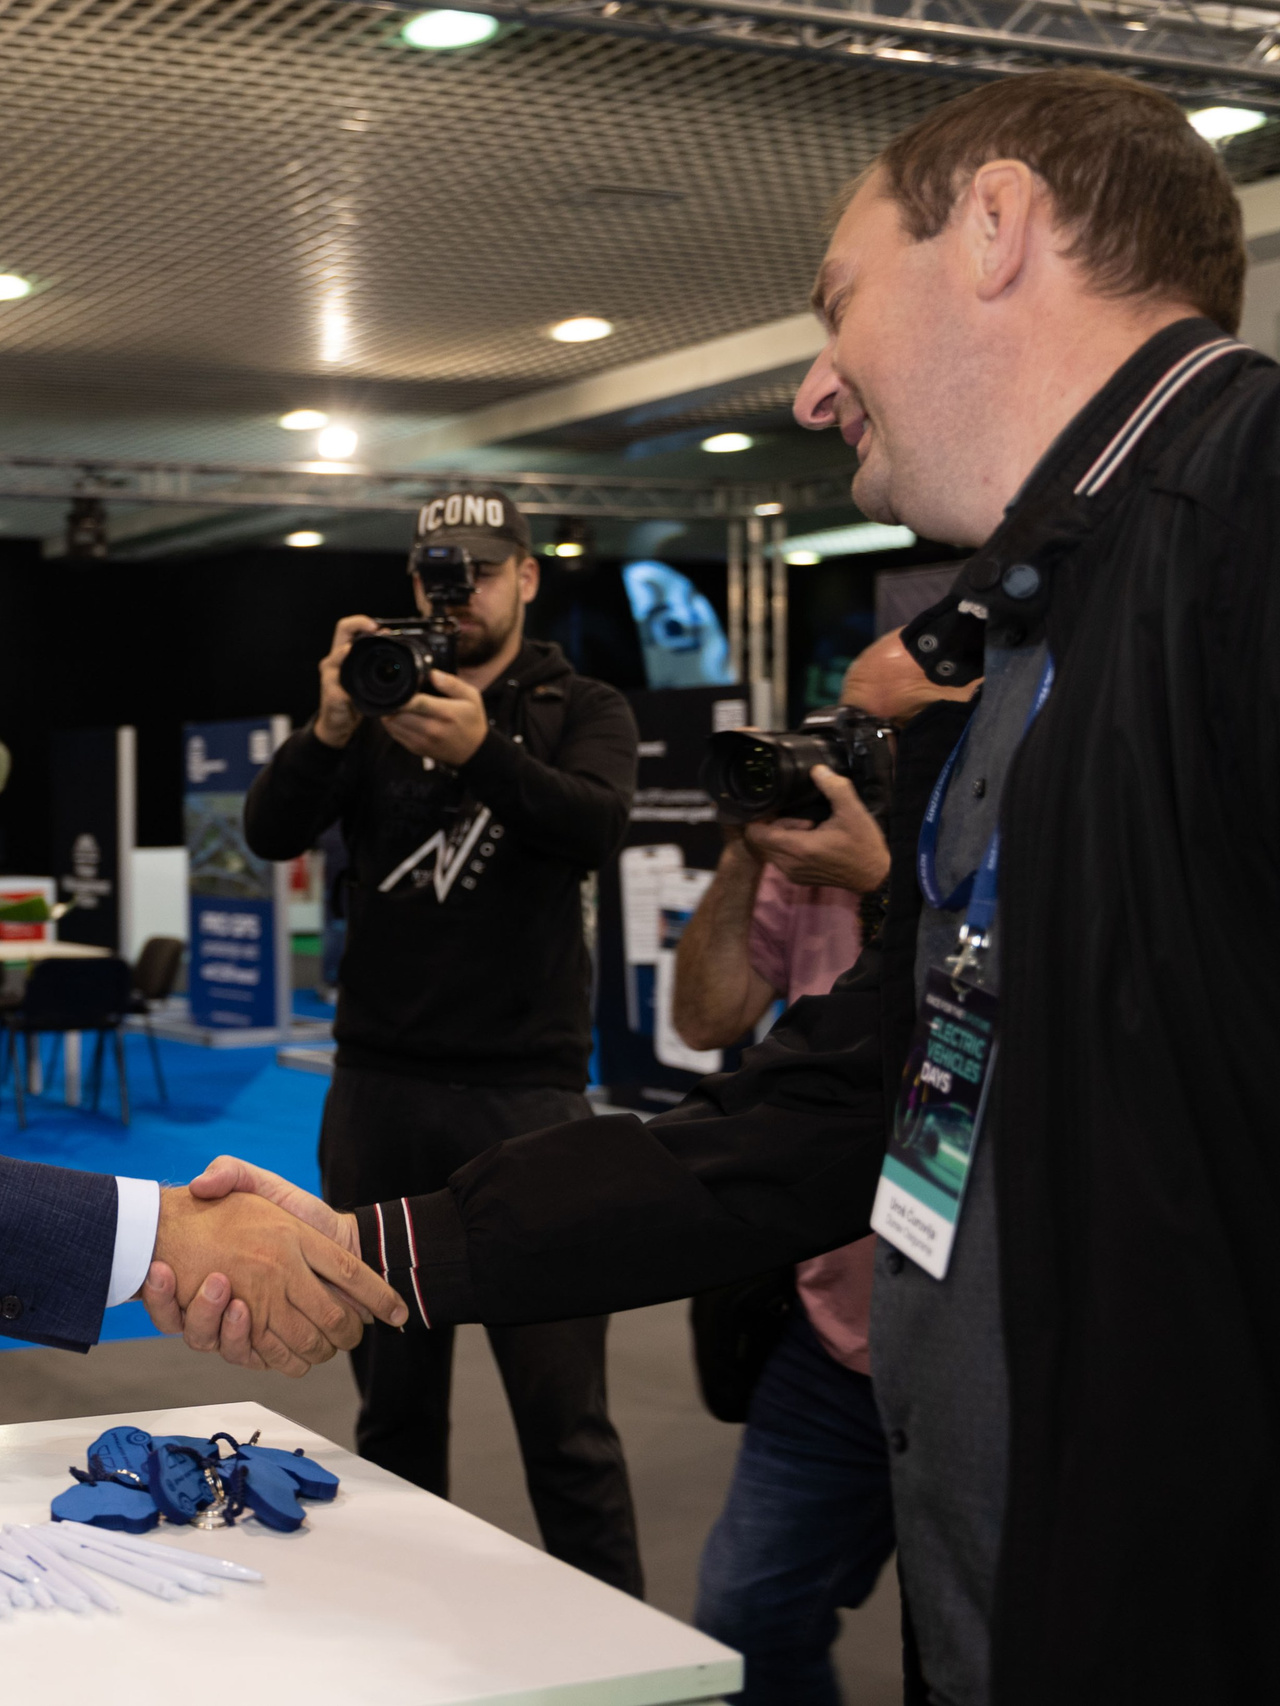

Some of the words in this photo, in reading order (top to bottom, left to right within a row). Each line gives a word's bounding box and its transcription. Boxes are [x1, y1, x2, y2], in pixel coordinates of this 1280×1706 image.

[418, 494, 505, 536] ICONO
[930, 1016, 986, 1060] ELECTRIC
[921, 1060, 952, 1093] DAYS
[927, 1039, 982, 1084] VEHICLES
